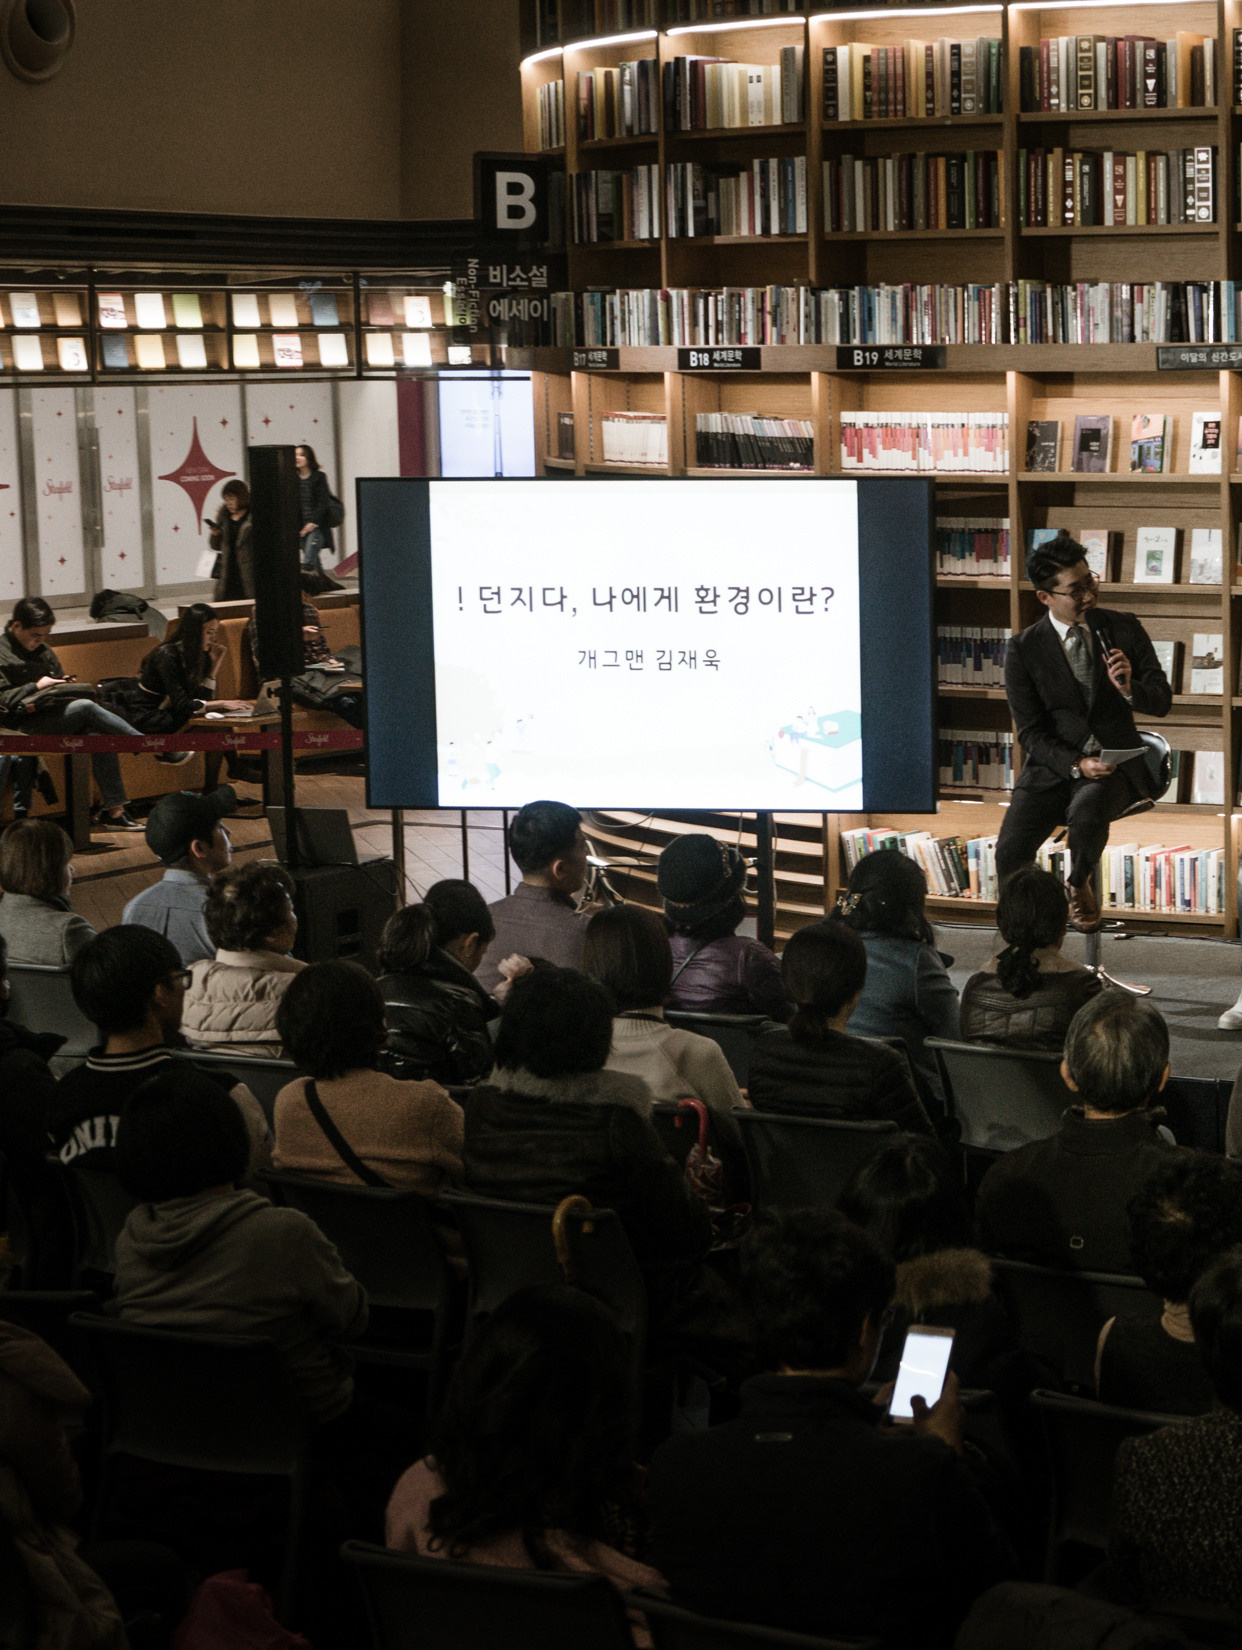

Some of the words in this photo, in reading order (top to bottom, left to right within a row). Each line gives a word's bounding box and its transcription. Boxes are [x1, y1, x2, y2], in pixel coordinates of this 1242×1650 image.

[495, 171, 537, 229] B
[489, 264, 549, 288] 비소설
[467, 258, 480, 333] Non-Fiction
[489, 298, 549, 322] 에세이
[689, 351, 710, 367] B18
[712, 349, 743, 362] 세계문학
[853, 349, 879, 366] B19
[884, 348, 923, 360] 세계문학
[1180, 352, 1207, 363] 이달의
[478, 585, 578, 617] 던지다,
[591, 585, 680, 612] 나에게
[694, 584, 836, 615] 환경이란?
[577, 649, 645, 671] 개그맨
[655, 648, 721, 671] 김재욱
